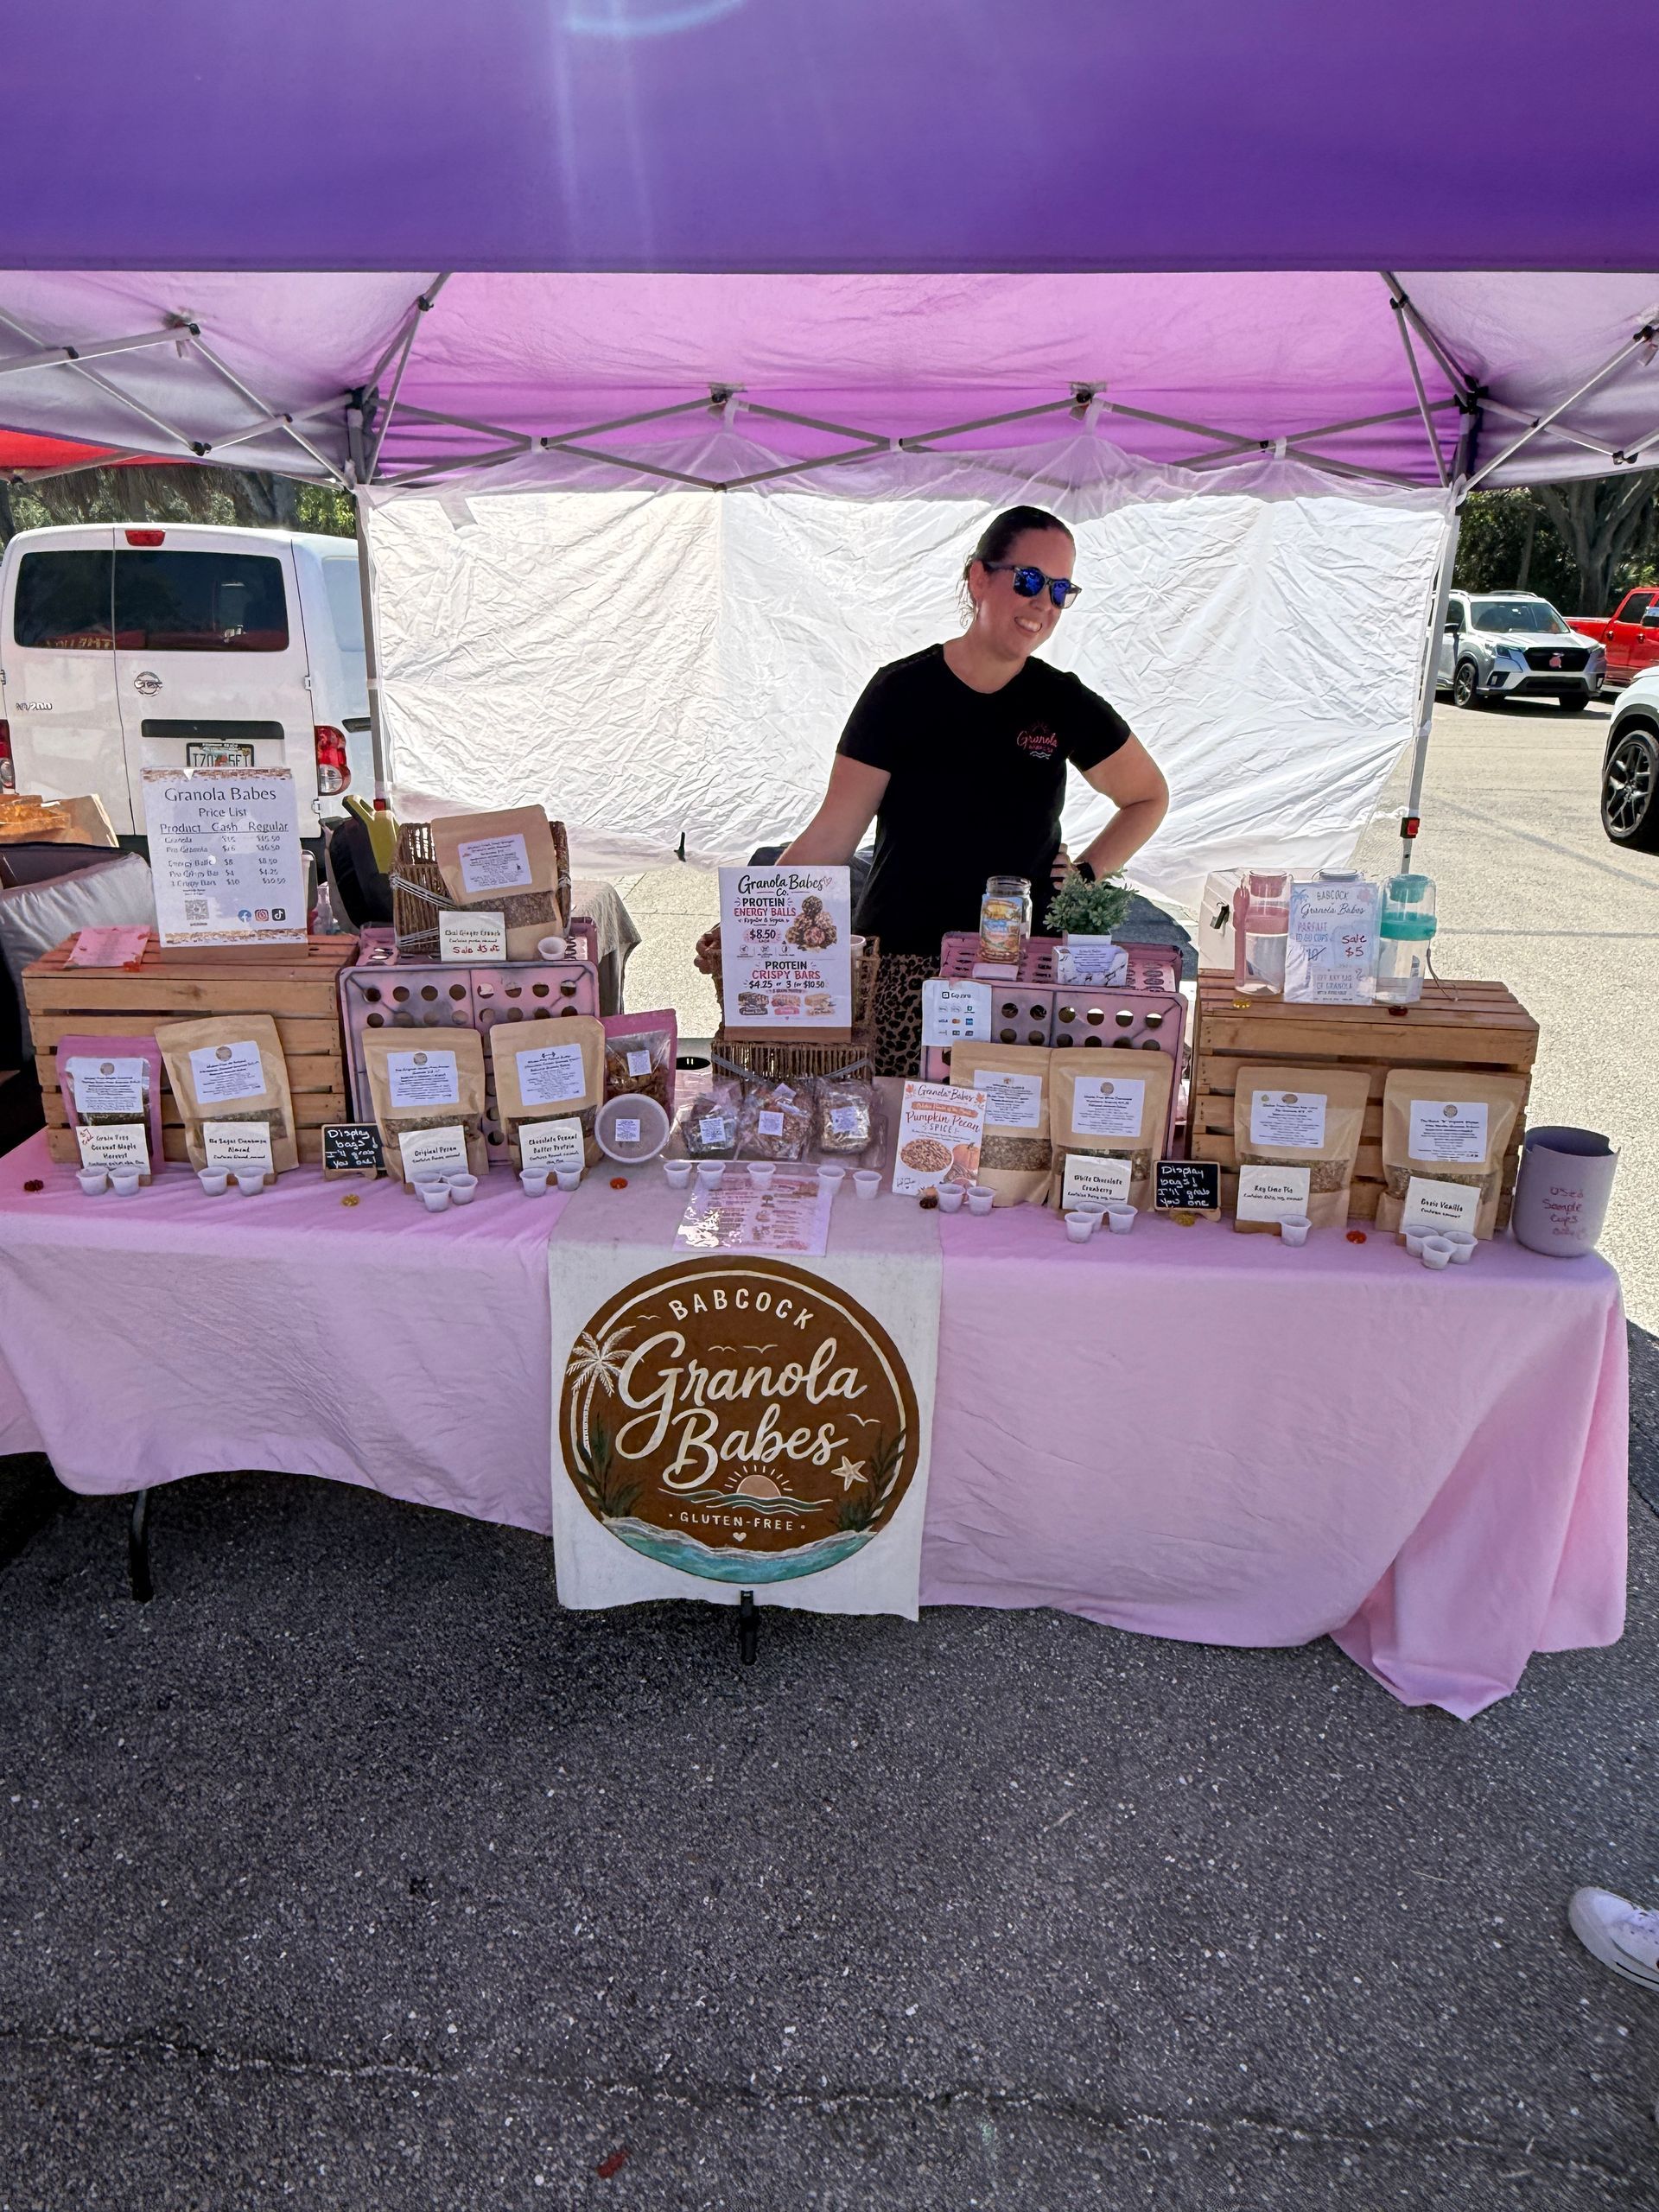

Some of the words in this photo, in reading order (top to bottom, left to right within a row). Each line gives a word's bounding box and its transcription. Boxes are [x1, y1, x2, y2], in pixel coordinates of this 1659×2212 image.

[164, 787, 226, 802] Granola
[230, 786, 276, 800] Babes
[199, 807, 226, 817] Price
[228, 807, 247, 817] List
[159, 823, 200, 834] Product
[211, 823, 238, 833] Cash
[247, 821, 289, 834] Regular
[738, 873, 788, 895] Granola
[788, 873, 823, 892] Babes
[776, 888, 789, 897] Co.
[1317, 890, 1348, 900] BABCOCK
[742, 898, 785, 907] PROTEIN
[734, 907, 769, 917] ENERGY
[771, 907, 797, 916] BALLS
[1300, 902, 1337, 918] Granola
[1338, 902, 1365, 916] Babes
[750, 928, 776, 940] $8.50
[1341, 935, 1367, 944] Sale
[1344, 945, 1363, 957] $5
[765, 961, 807, 969] PROTEIN
[752, 970, 791, 980] CRISPY
[795, 970, 821, 980] BARS
[748, 980, 772, 988] $4.25
[786, 980, 791, 988] 3
[804, 980, 824, 988] $10.50
[918, 1085, 949, 1097] Granola
[950, 1089, 975, 1103] Babes
[906, 1111, 950, 1123] Pumpkin
[952, 1115, 981, 1134] Pecan
[327, 1128, 370, 1139] Display
[930, 1123, 952, 1134] SPICE
[334, 1160, 349, 1168] you
[1161, 1166, 1205, 1179] Display
[1160, 1198, 1180, 1207] you
[669, 1288, 814, 1329] BABCOCK
[615, 1331, 868, 1459] Granola
[662, 1403, 849, 1489] Babes
[679, 1511, 794, 1532] GLUTEN-FREE
